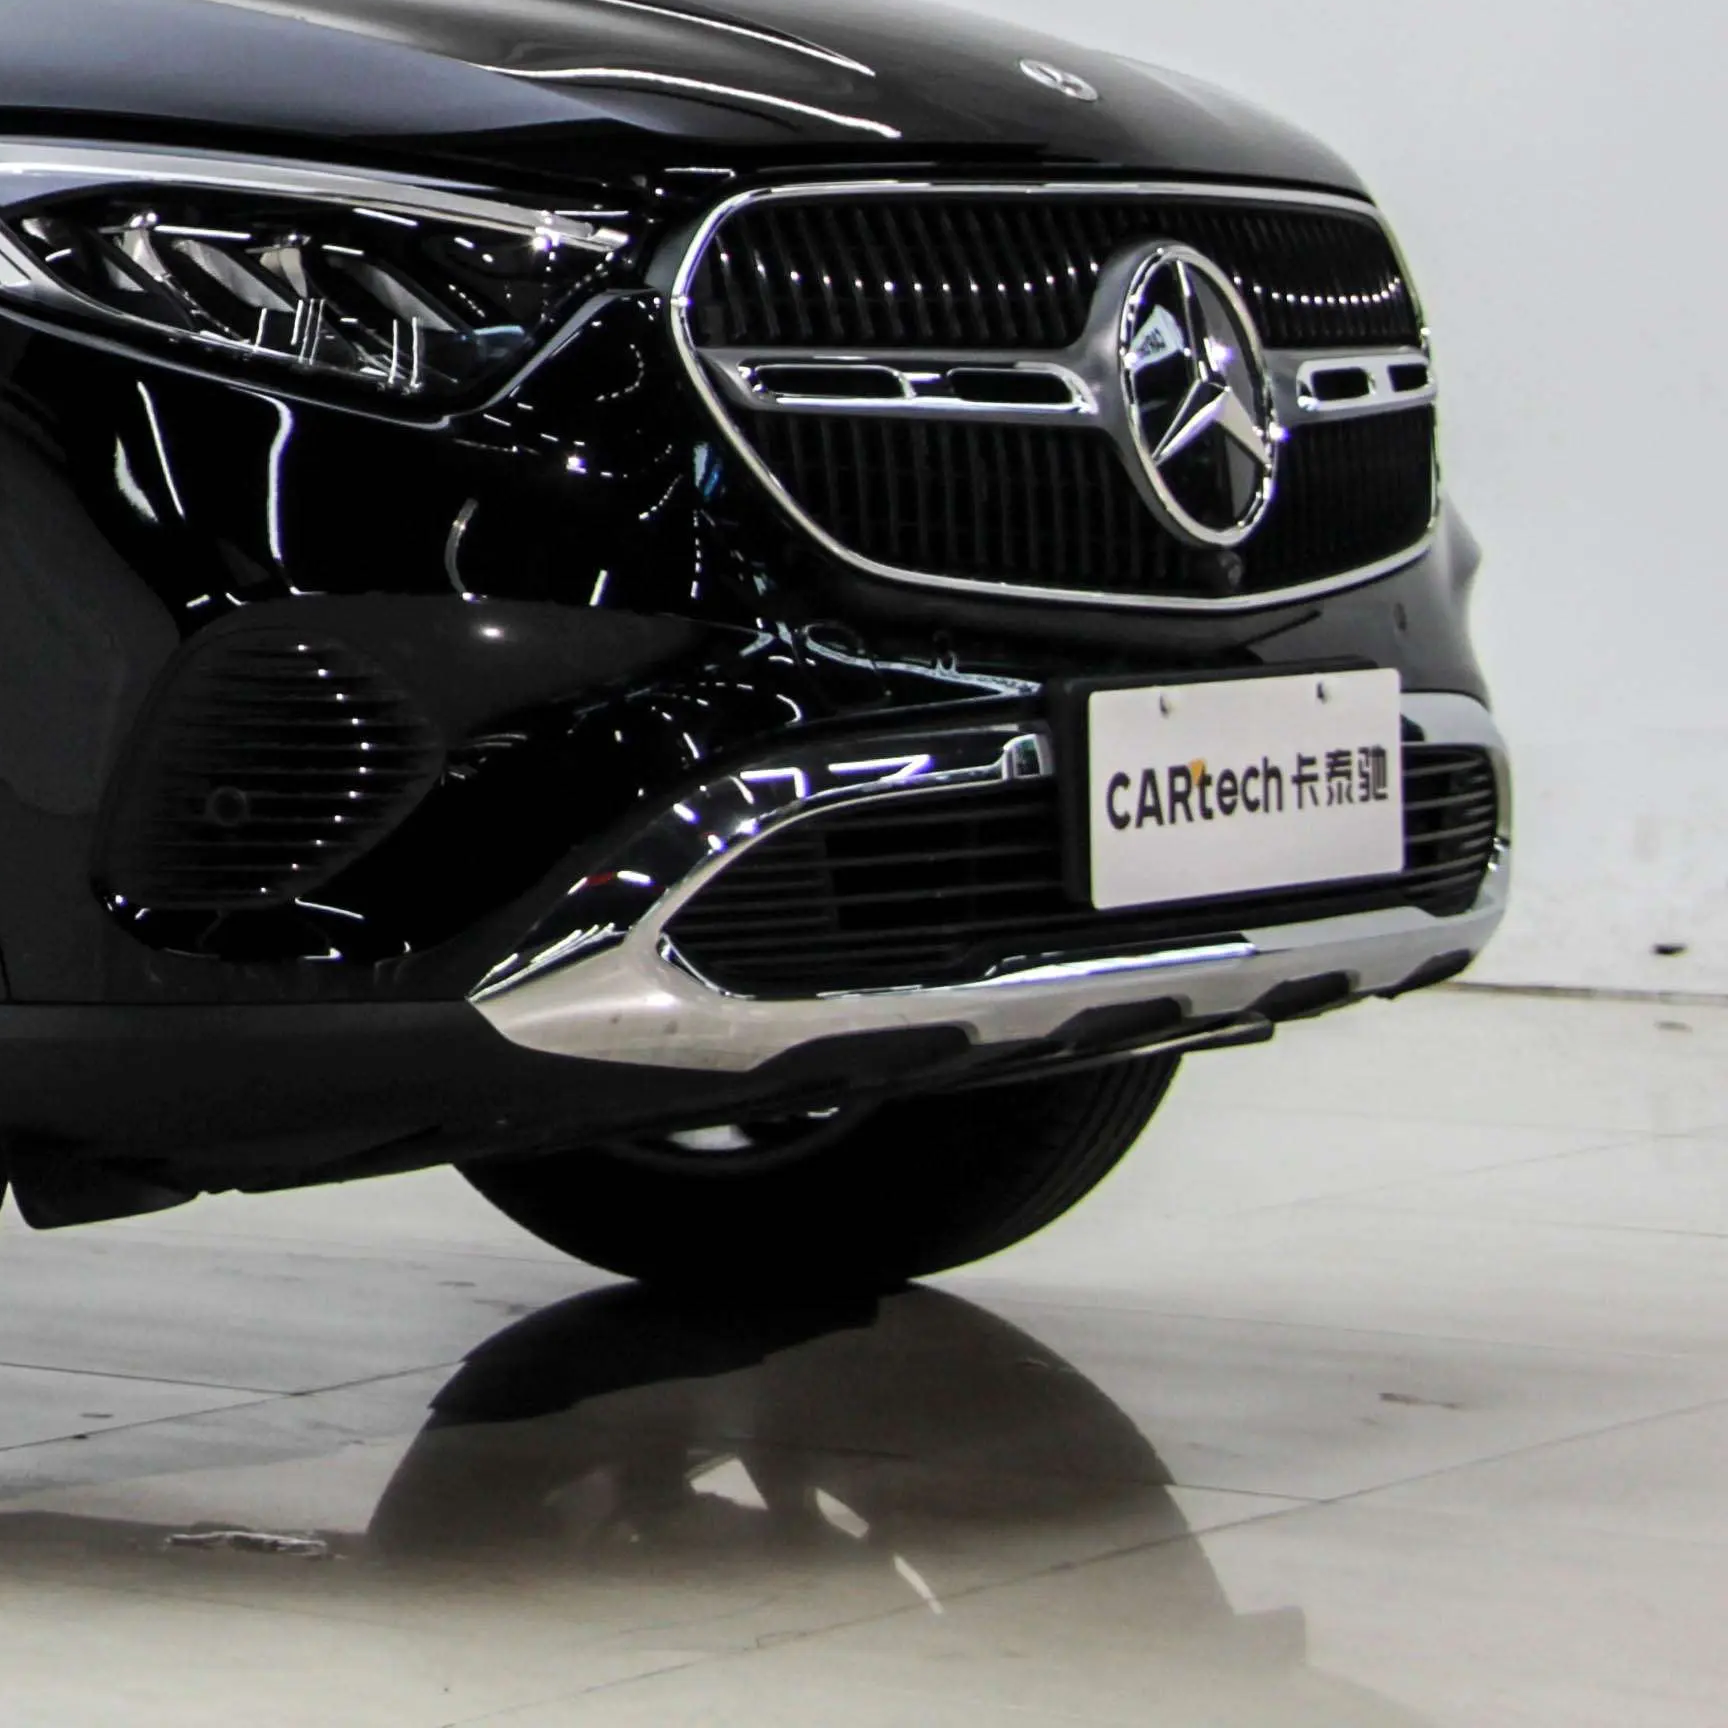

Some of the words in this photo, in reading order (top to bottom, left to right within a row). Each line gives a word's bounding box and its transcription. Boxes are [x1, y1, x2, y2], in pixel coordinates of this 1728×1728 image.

[1106, 755, 1283, 831] CARtech
[1291, 745, 1389, 810] 卡泰驰
